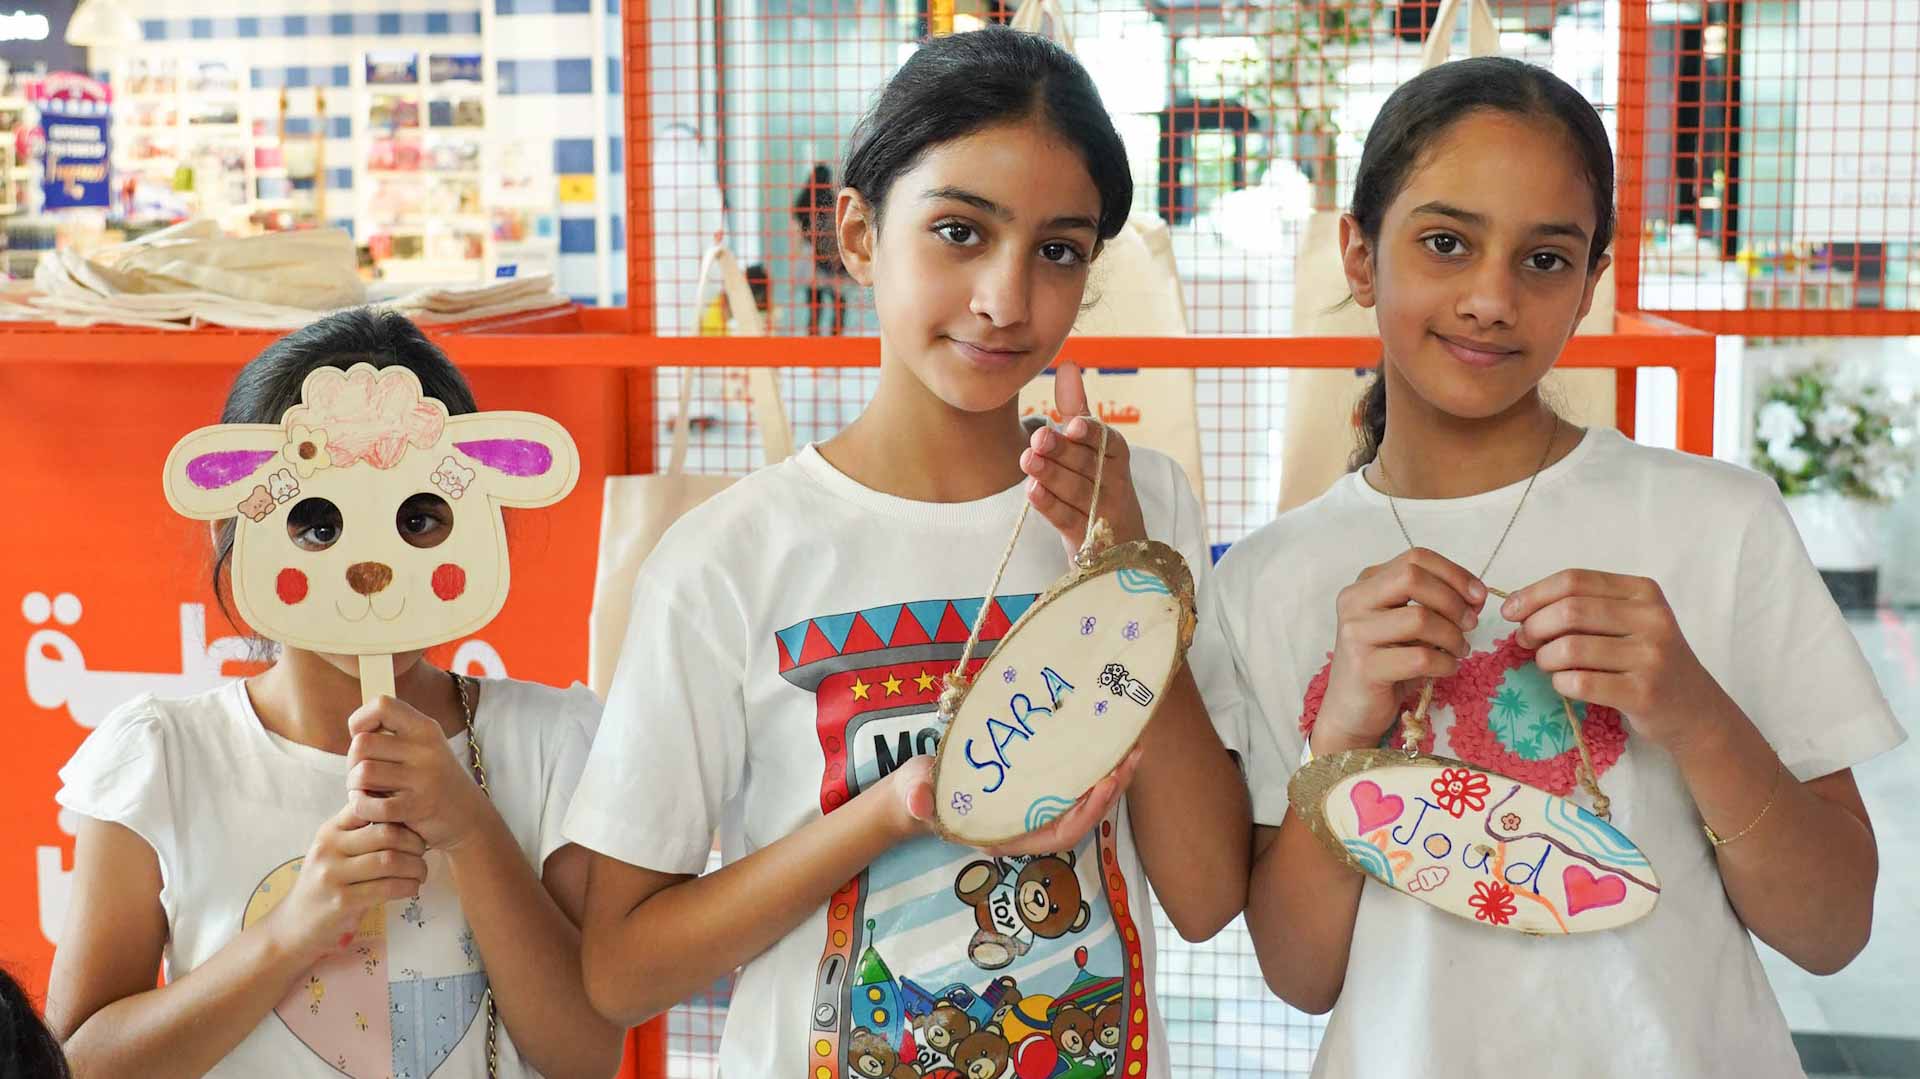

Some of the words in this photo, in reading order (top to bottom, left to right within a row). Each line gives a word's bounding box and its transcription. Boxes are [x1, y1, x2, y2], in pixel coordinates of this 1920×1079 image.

[22, 592, 507, 728] مطة
[965, 667, 1074, 792] SARA
[1393, 797, 1551, 894] Joud
[992, 891, 1016, 930] TOY
